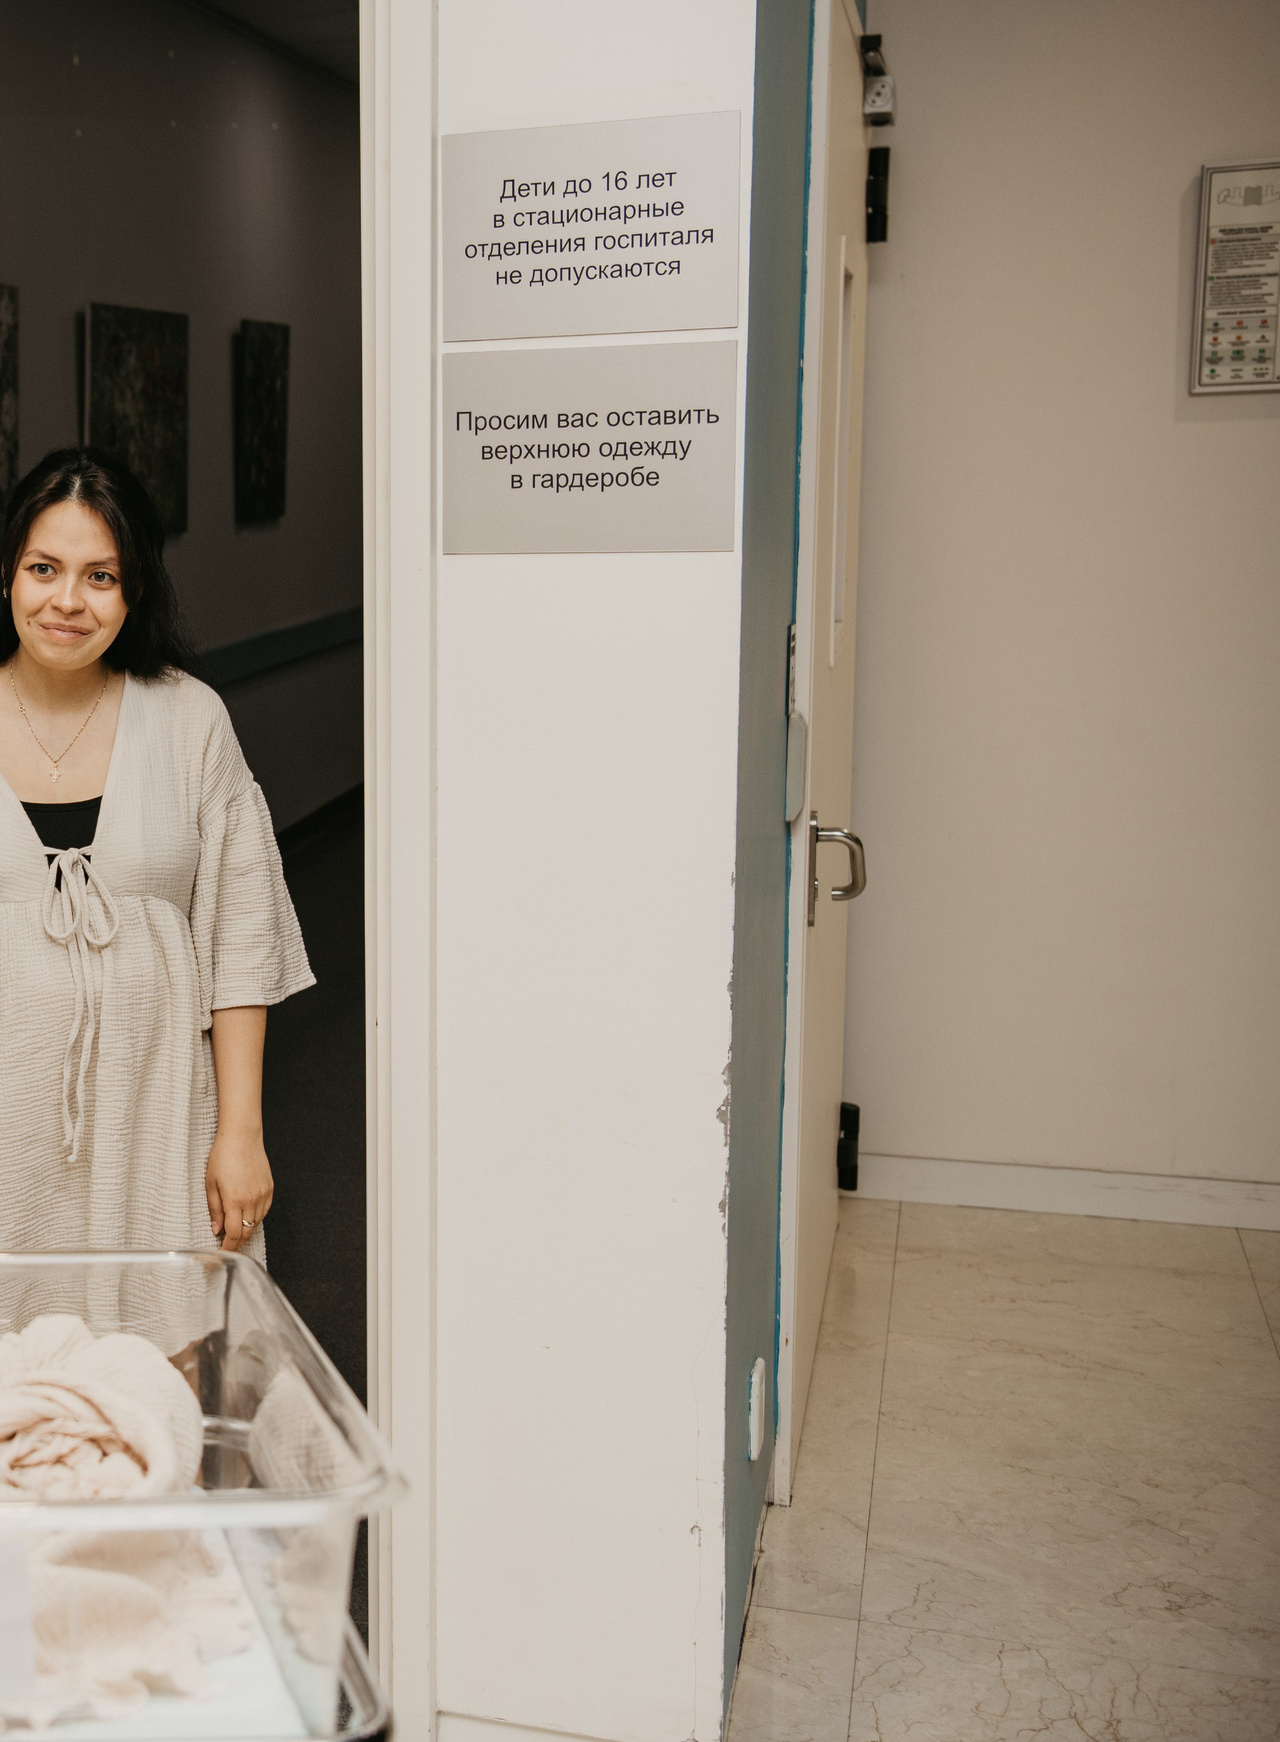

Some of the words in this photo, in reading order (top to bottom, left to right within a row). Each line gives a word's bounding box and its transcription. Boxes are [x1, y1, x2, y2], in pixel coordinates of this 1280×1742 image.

[499, 179, 555, 204] Дети
[562, 178, 592, 199] до
[602, 171, 628, 192] 16
[635, 172, 677, 190] лет
[493, 213, 505, 229] в
[513, 201, 685, 228] стационарные
[464, 237, 586, 261] отделения
[594, 228, 714, 251] госпиталя
[496, 270, 523, 286] не
[529, 260, 681, 288] допускаются
[456, 411, 548, 436] Просим
[557, 412, 599, 428] вас
[606, 408, 720, 427] оставить
[481, 443, 591, 465] верхнюю
[598, 440, 692, 461] одежду
[510, 474, 523, 489] в
[532, 466, 660, 493] гардеробе
